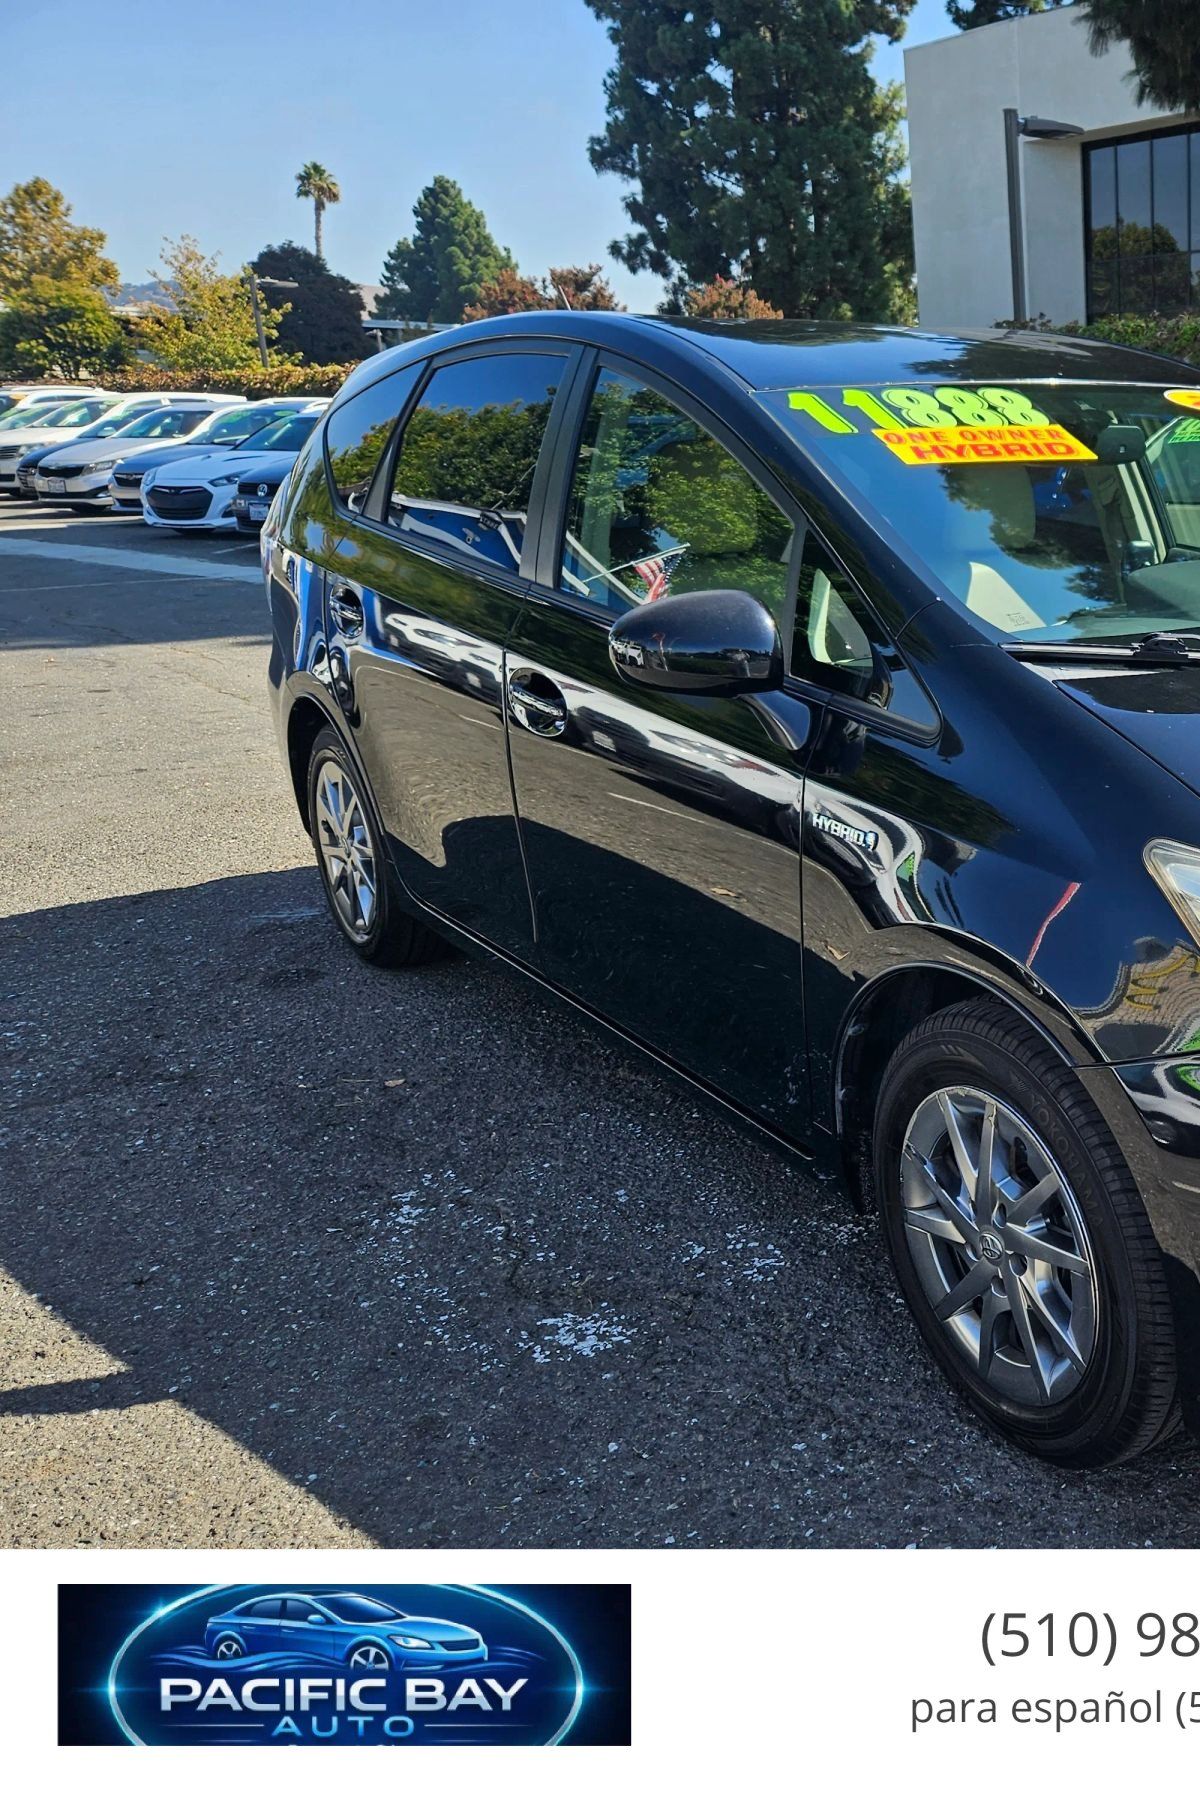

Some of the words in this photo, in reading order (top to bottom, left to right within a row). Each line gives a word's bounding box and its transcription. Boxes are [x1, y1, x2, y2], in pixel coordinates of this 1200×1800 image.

[788, 387, 1050, 434] 11888
[882, 431, 950, 445] ONE
[961, 429, 1066, 443] OWNER
[909, 440, 1079, 461] HYBRID
[812, 813, 866, 847] HYBRID
